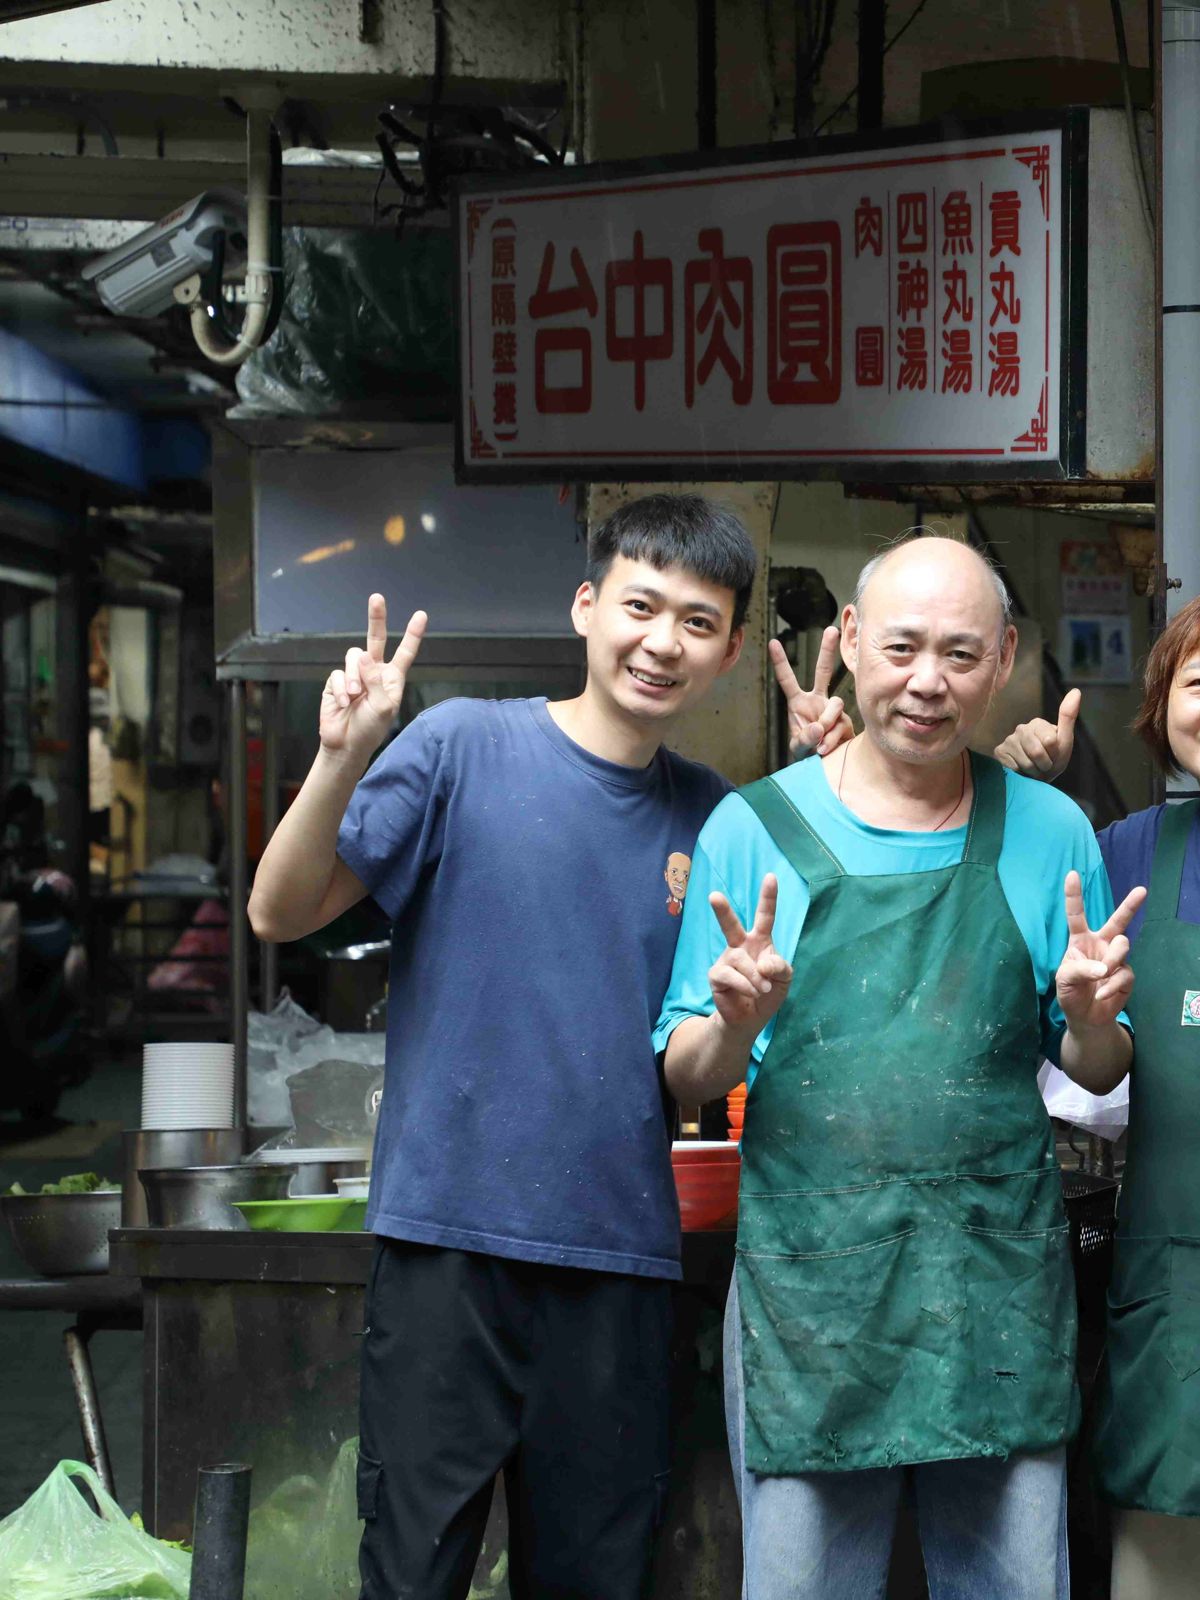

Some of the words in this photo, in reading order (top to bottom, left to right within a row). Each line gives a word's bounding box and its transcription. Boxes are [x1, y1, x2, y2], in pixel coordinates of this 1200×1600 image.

[528, 221, 843, 415] 台中肉圓
[854, 197, 886, 388] 肉圓
[896, 191, 930, 391] 四神湯
[941, 190, 975, 395] 魚丸湯
[988, 191, 1022, 397] 貢丸湯
